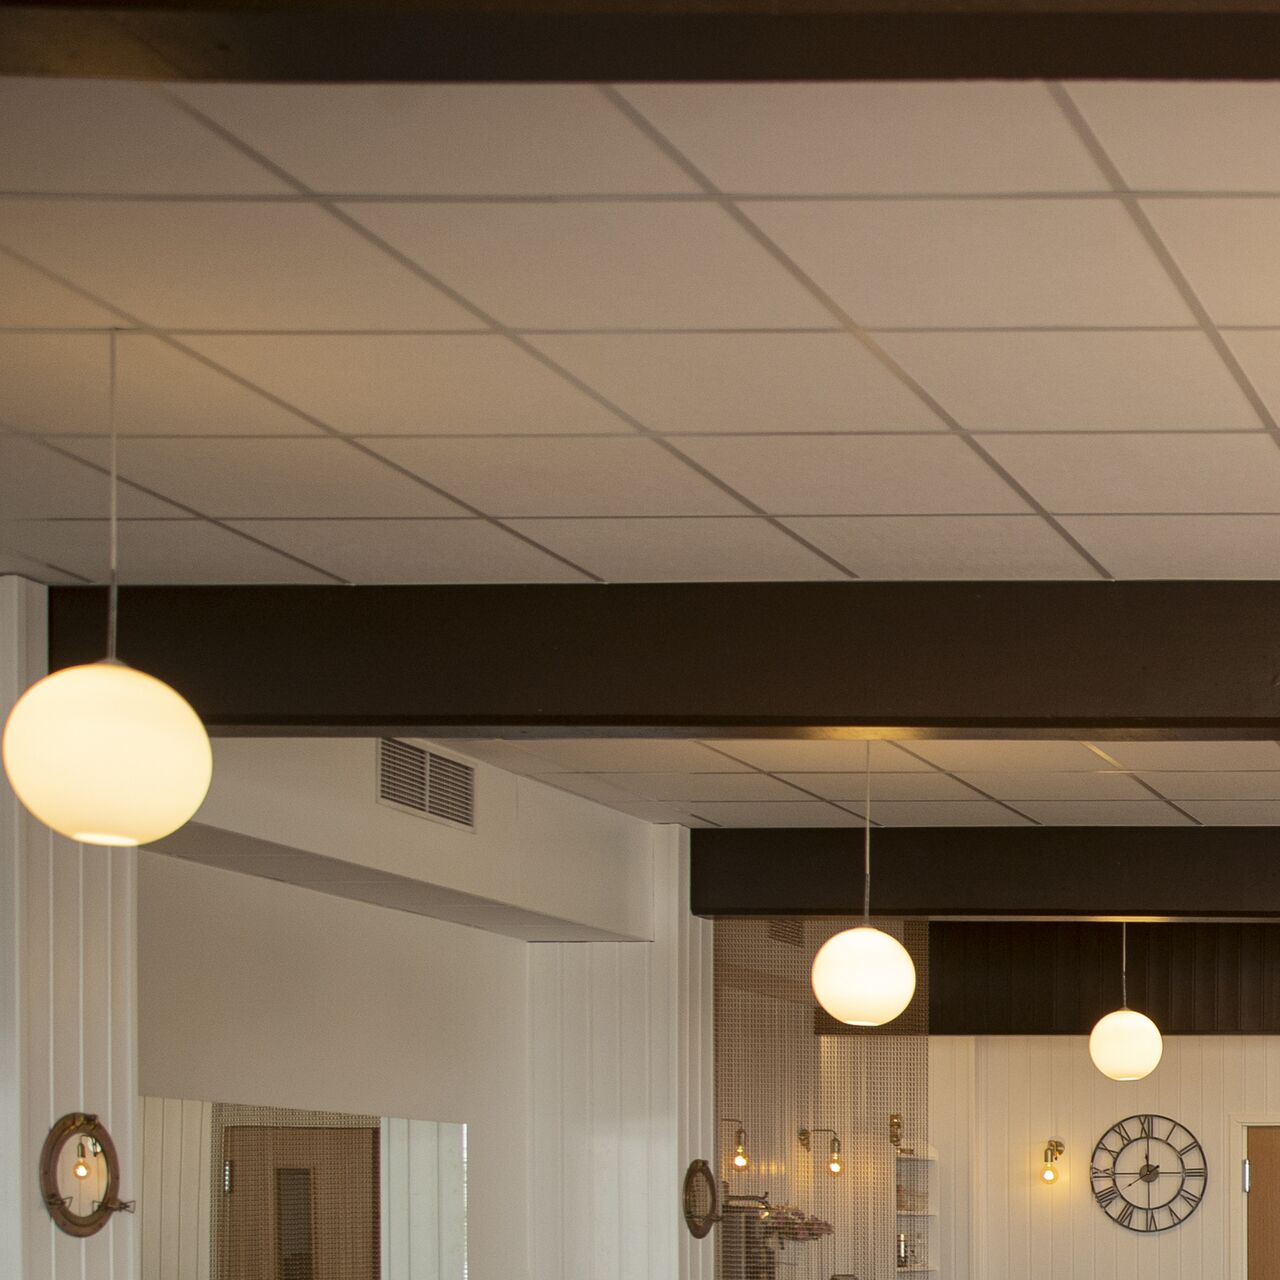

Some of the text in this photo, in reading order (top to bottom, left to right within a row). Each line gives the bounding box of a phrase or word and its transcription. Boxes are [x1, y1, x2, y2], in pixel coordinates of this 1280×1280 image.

[1112, 1122, 1131, 1146] XI
[1138, 1116, 1153, 1138] XII
[1165, 1122, 1177, 1141] I
[1098, 1141, 1119, 1159] X
[1179, 1141, 1199, 1156] II
[1185, 1168, 1205, 1177] III
[1180, 1188, 1201, 1209] IV
[1116, 1203, 1135, 1227] VII
[1146, 1209, 1157, 1231] VI
[1168, 1205, 1181, 1225] V
